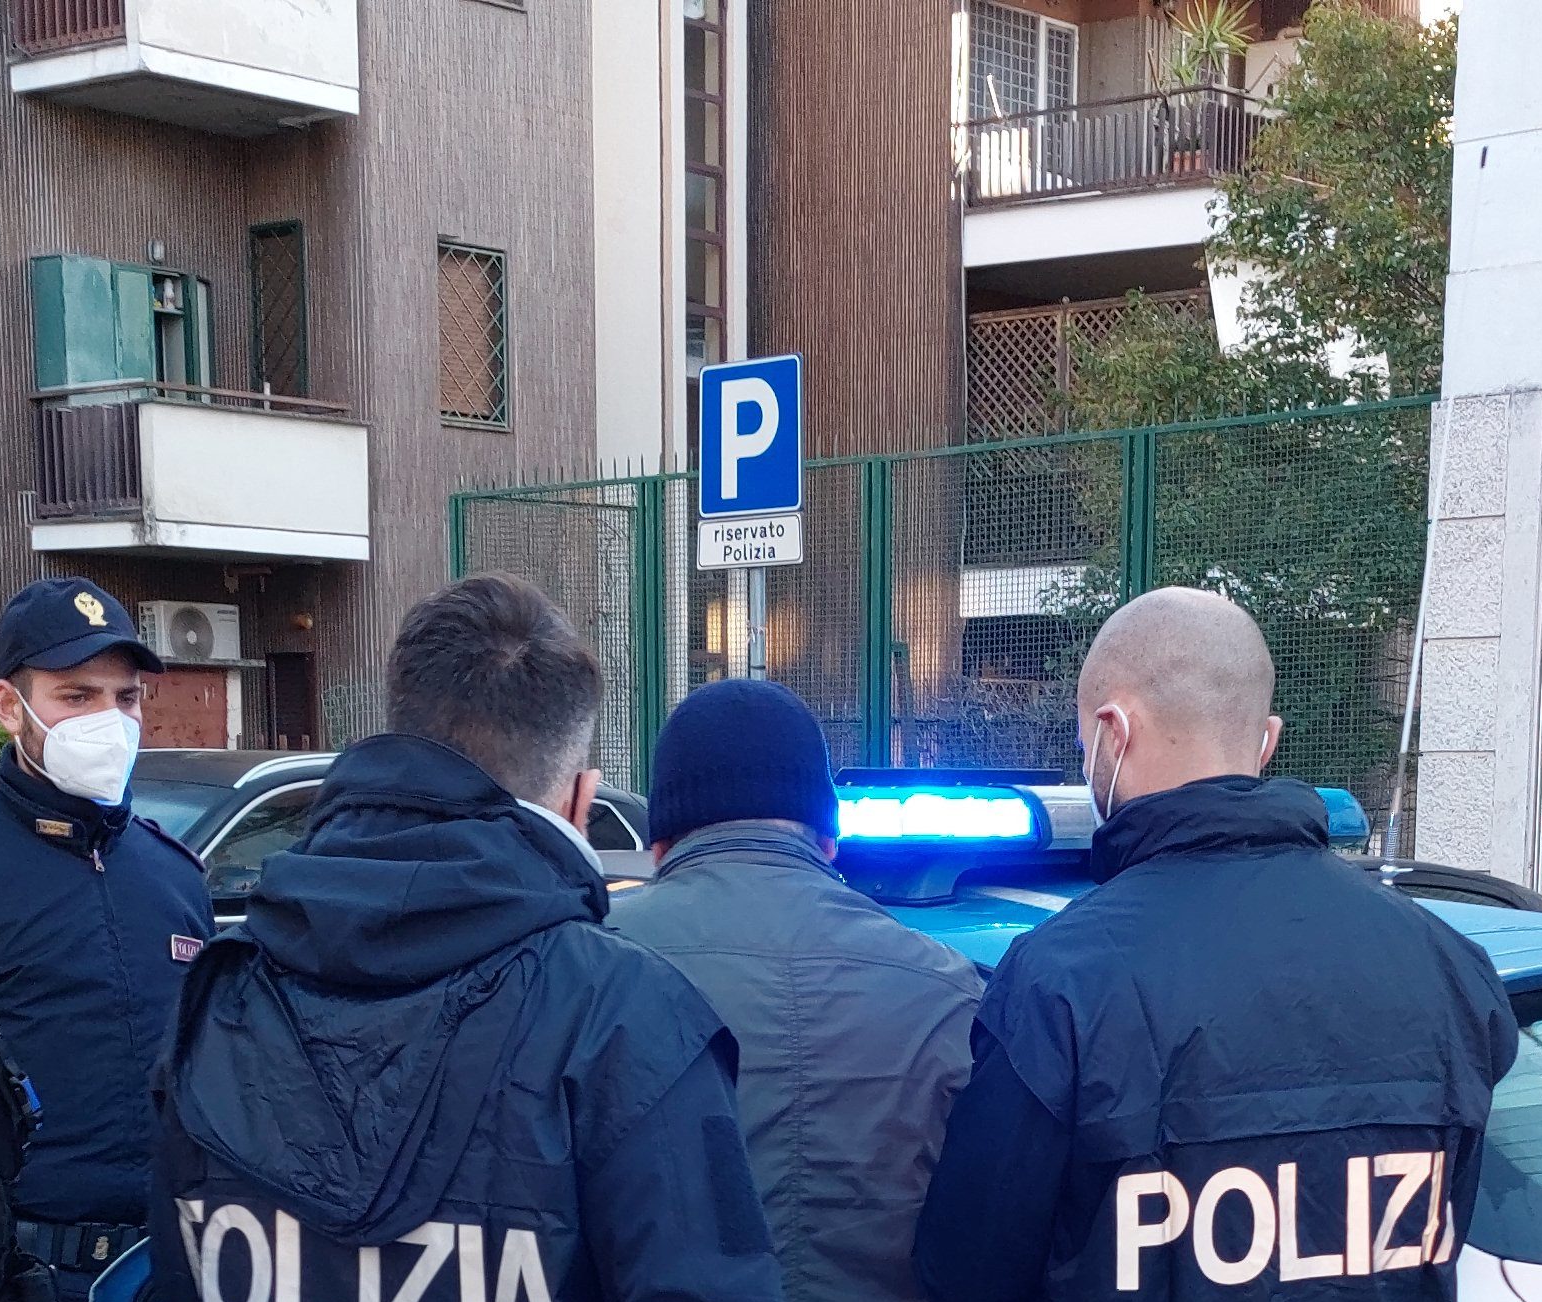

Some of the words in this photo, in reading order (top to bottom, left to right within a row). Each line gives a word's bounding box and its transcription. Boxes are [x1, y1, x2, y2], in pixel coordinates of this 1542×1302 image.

[721, 377, 780, 500] P
[713, 520, 786, 544] riservato
[722, 542, 777, 563] Polizia
